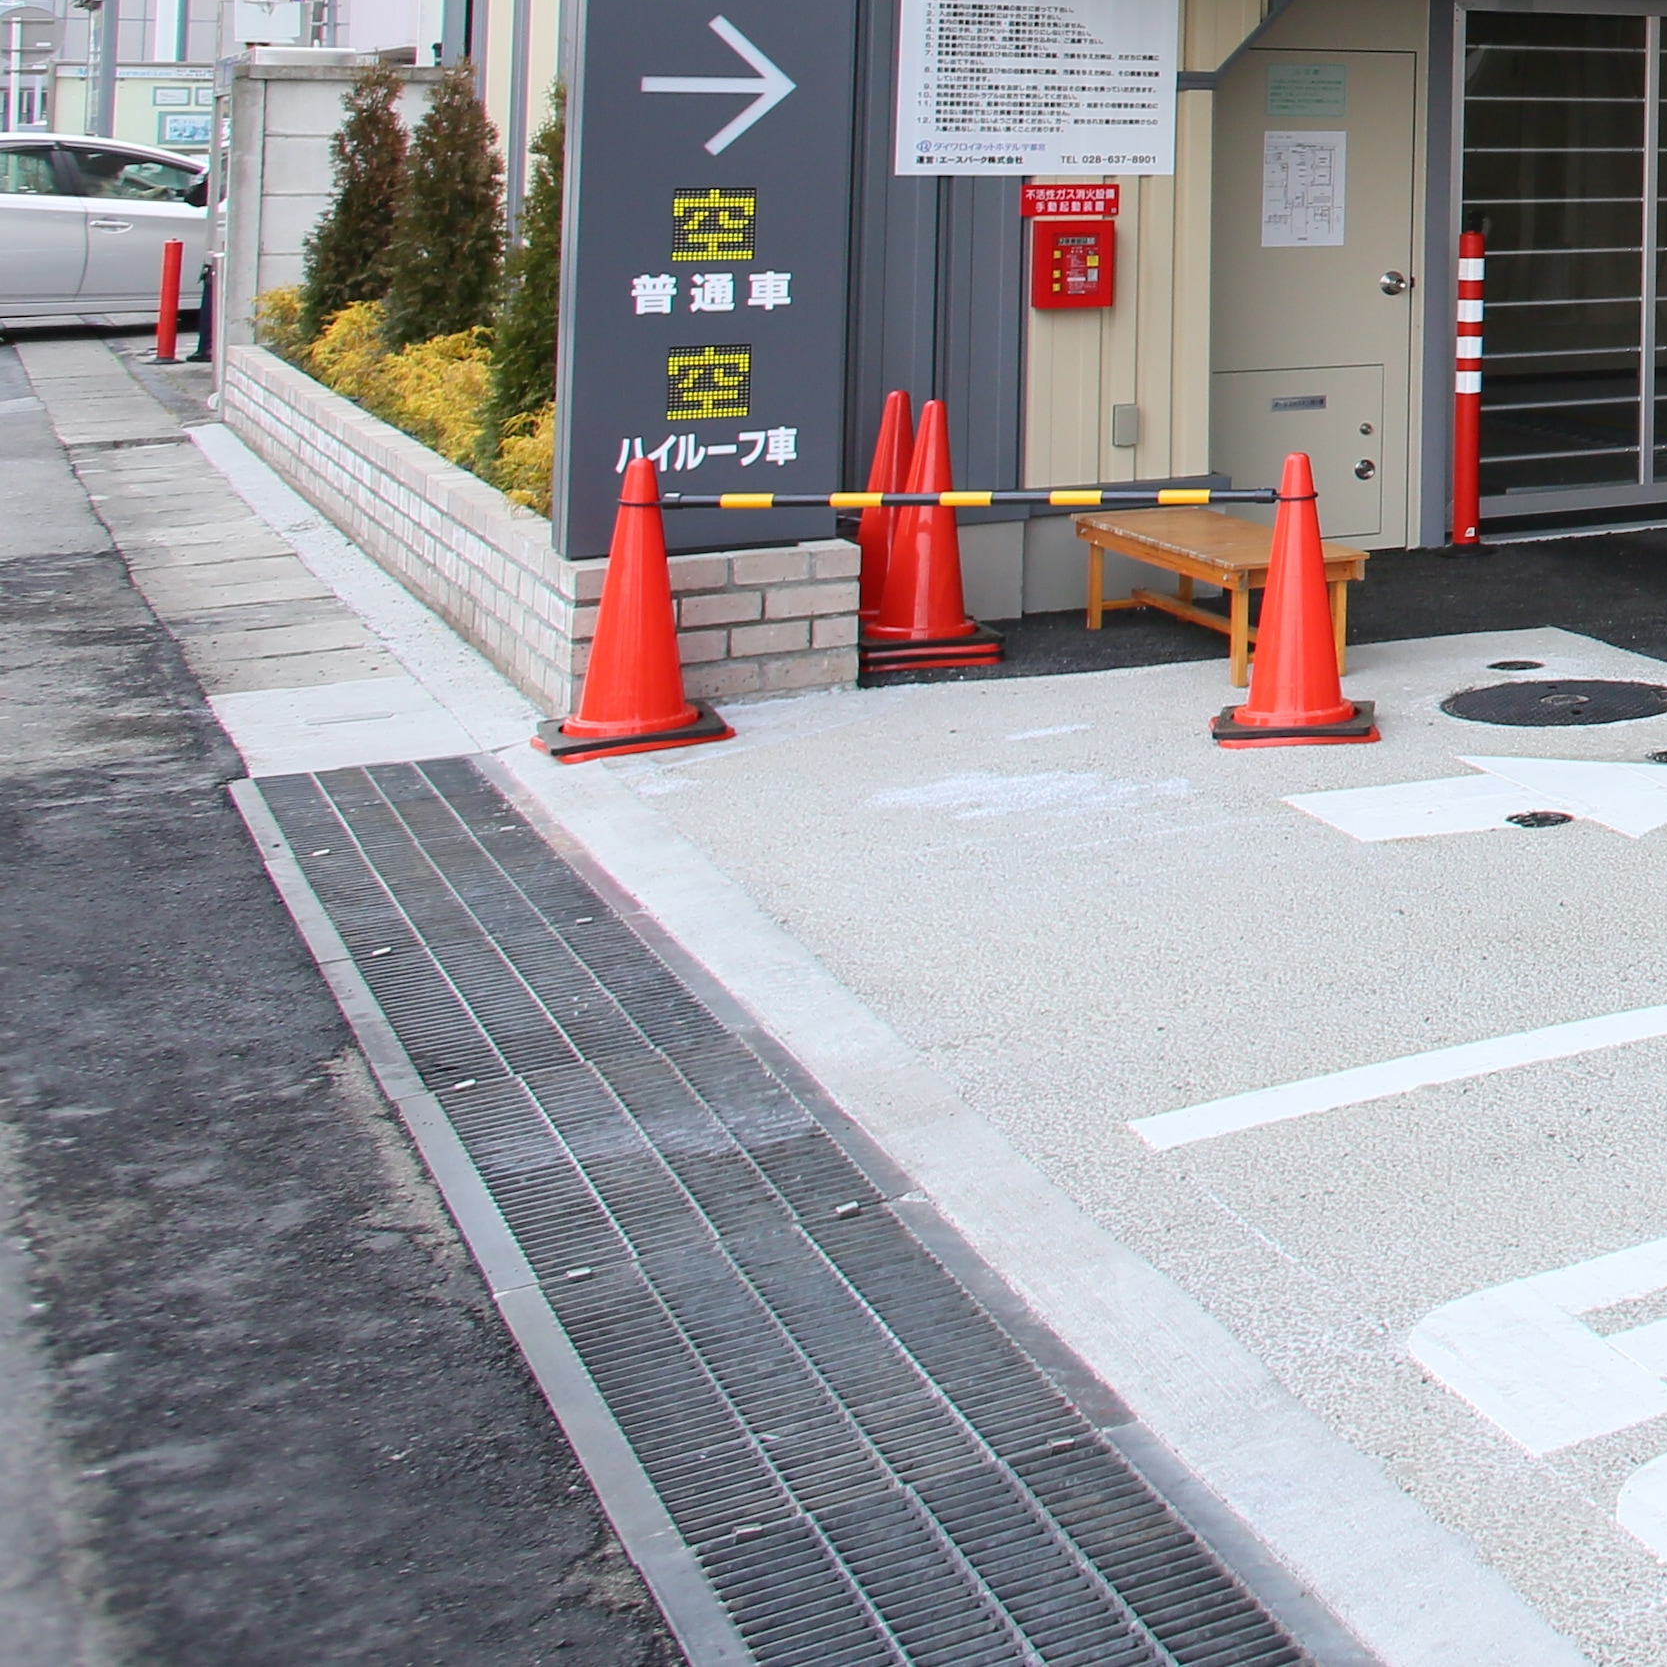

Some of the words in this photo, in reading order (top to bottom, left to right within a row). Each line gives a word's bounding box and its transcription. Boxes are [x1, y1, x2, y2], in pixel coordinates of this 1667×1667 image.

[1060, 155, 1078, 164] TEL
[1082, 155, 1157, 164] 028-637-8901
[671, 188, 756, 261] 空
[631, 270, 792, 315] 普通車
[666, 346, 750, 421] 空
[615, 426, 798, 474] ハイルーフ車
